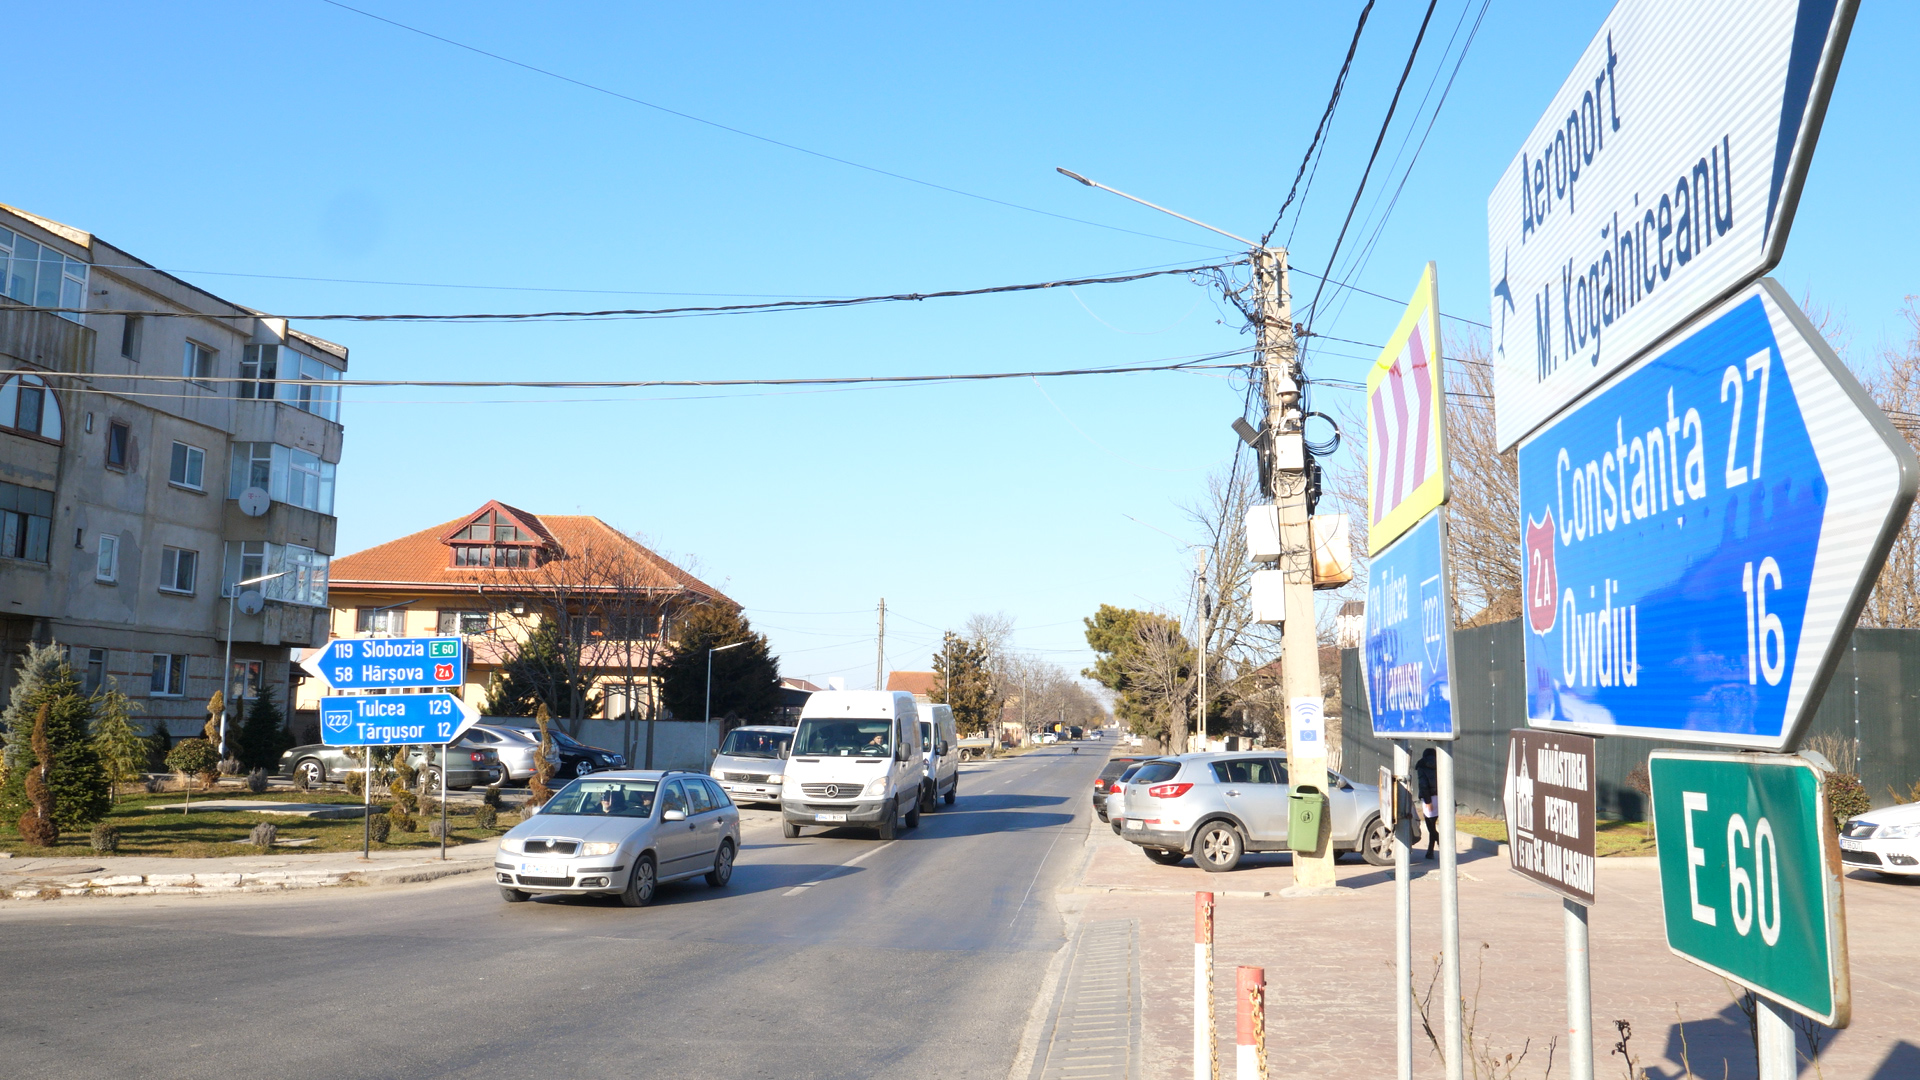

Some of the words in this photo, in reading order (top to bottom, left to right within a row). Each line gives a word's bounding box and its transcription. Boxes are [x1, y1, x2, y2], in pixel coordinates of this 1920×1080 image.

[1522, 28, 1620, 246] Aeroport
[1535, 284, 1557, 383] M.
[1562, 133, 1734, 367] Kogălniceanu
[1557, 384, 1707, 547] Constanța
[1720, 347, 1770, 489] 27
[1382, 565, 1408, 628] Tulcea
[1534, 548, 1551, 608] 2A
[1423, 595, 1440, 644] 222
[1562, 578, 1637, 688] Ovidiu
[1742, 555, 1786, 686] 16
[334, 643, 353, 659] 119
[362, 640, 424, 658] Slobozia
[432, 643, 439, 655] E
[442, 643, 454, 654] 60
[438, 669, 450, 678] 2A
[335, 667, 353, 682] 58
[362, 665, 423, 684] Hârșova
[1375, 665, 1383, 715] 12
[328, 715, 348, 726] 222
[356, 700, 405, 717] Tulcea
[429, 700, 451, 715] 129
[356, 723, 425, 743] Tărgușor
[437, 722, 451, 737] 12
[1518, 838, 1524, 866] 15
[1525, 841, 1534, 872] KM
[1544, 841, 1563, 882] IOAN
[1563, 848, 1594, 895] CASIAN
[1682, 791, 1716, 927] E
[1727, 813, 1781, 947] 60
